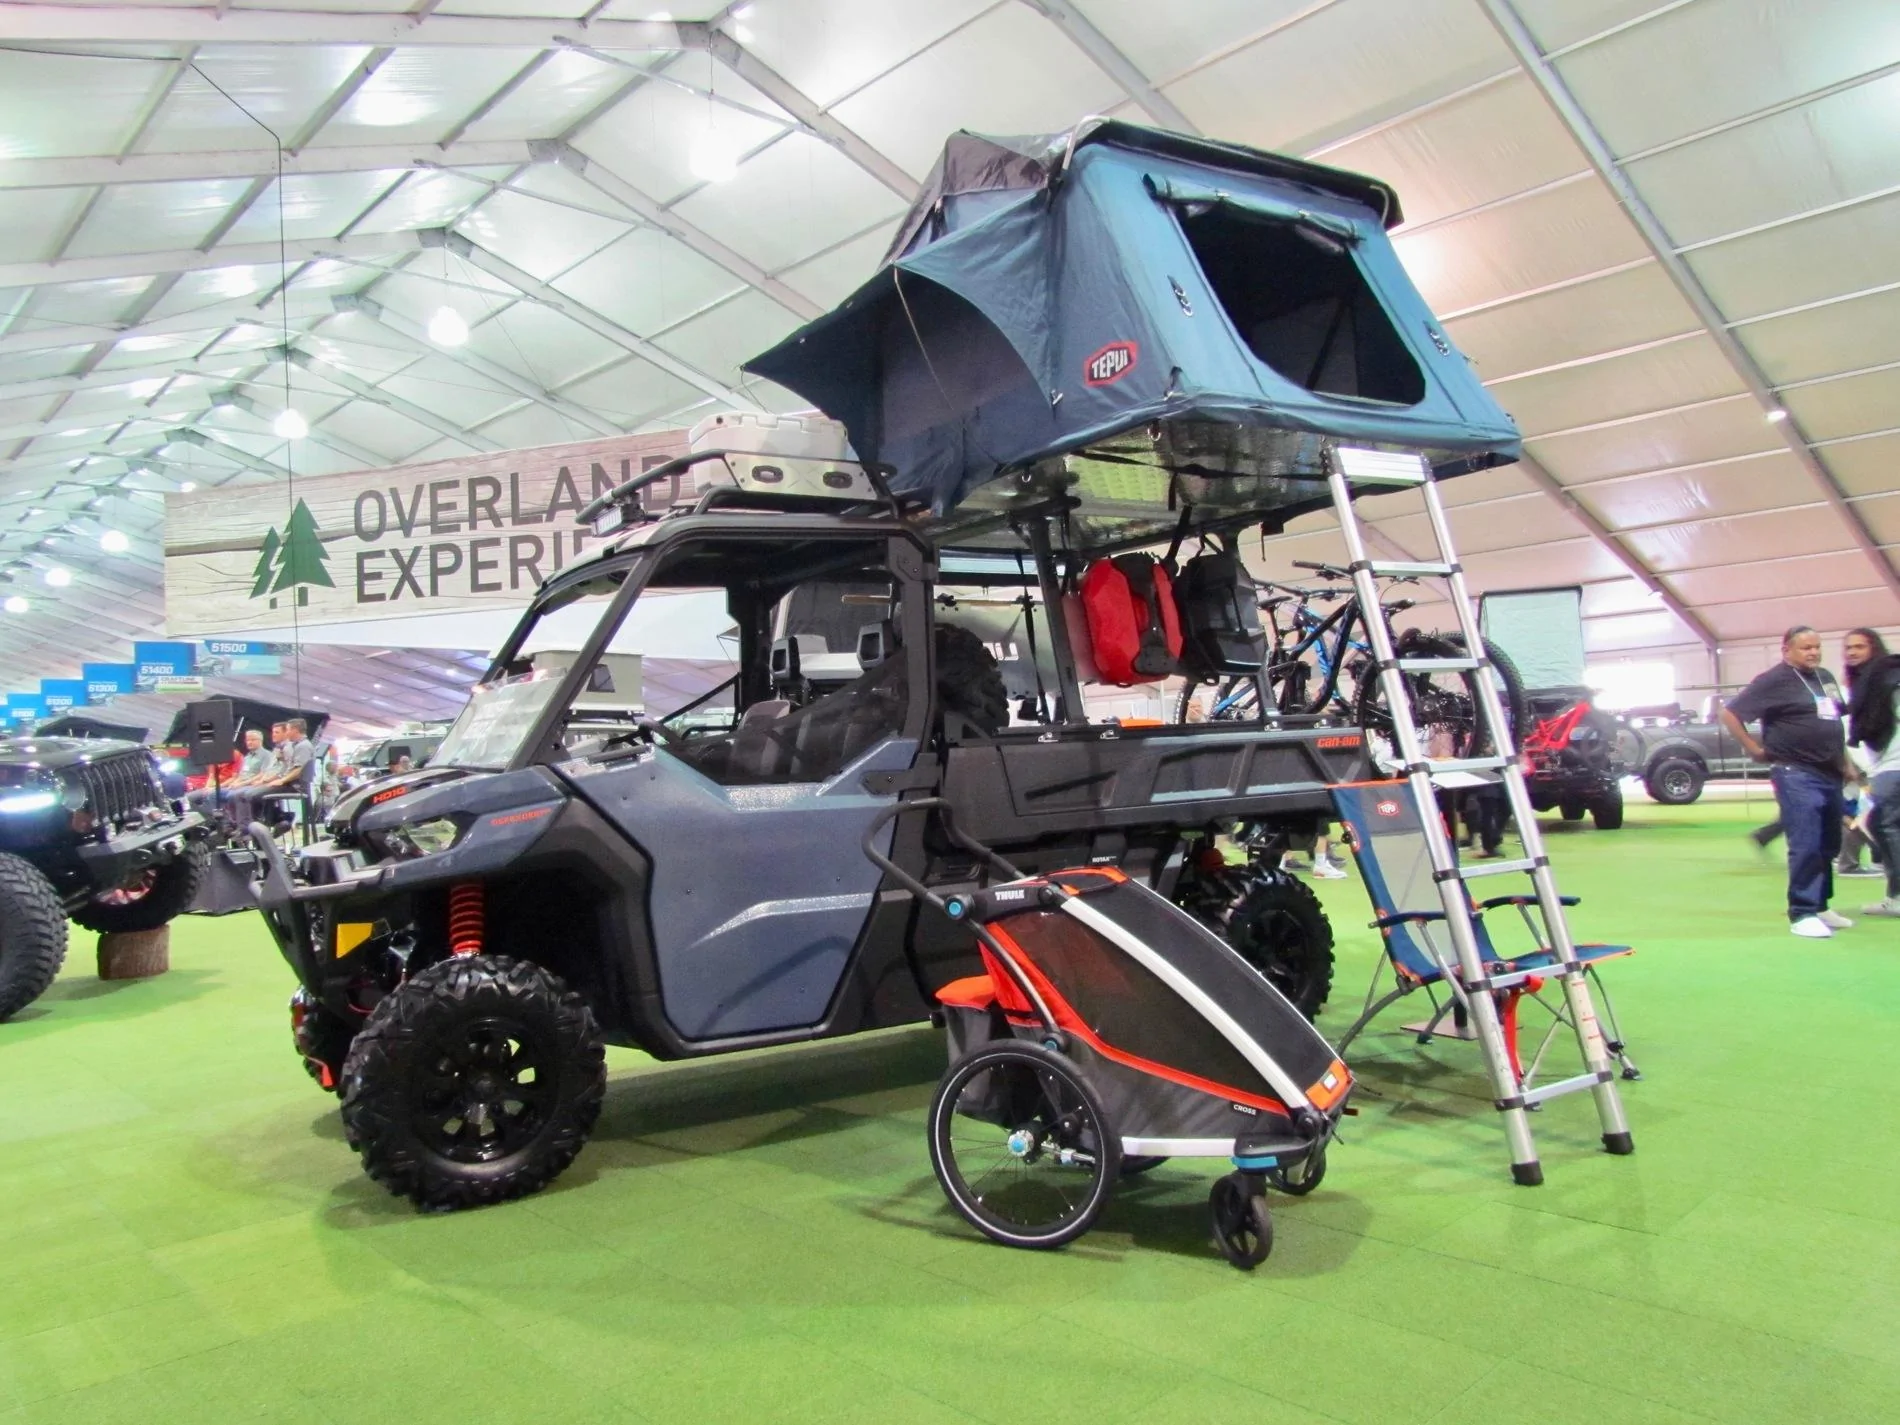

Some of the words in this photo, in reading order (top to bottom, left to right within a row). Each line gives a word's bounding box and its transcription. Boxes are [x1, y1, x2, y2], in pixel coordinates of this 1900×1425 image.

[1091, 349, 1128, 379] TEPUI
[354, 455, 681, 543] OVERLAND
[211, 642, 248, 653] 51500
[995, 889, 1025, 901] THULE
[1233, 1104, 1257, 1116] CROSS
